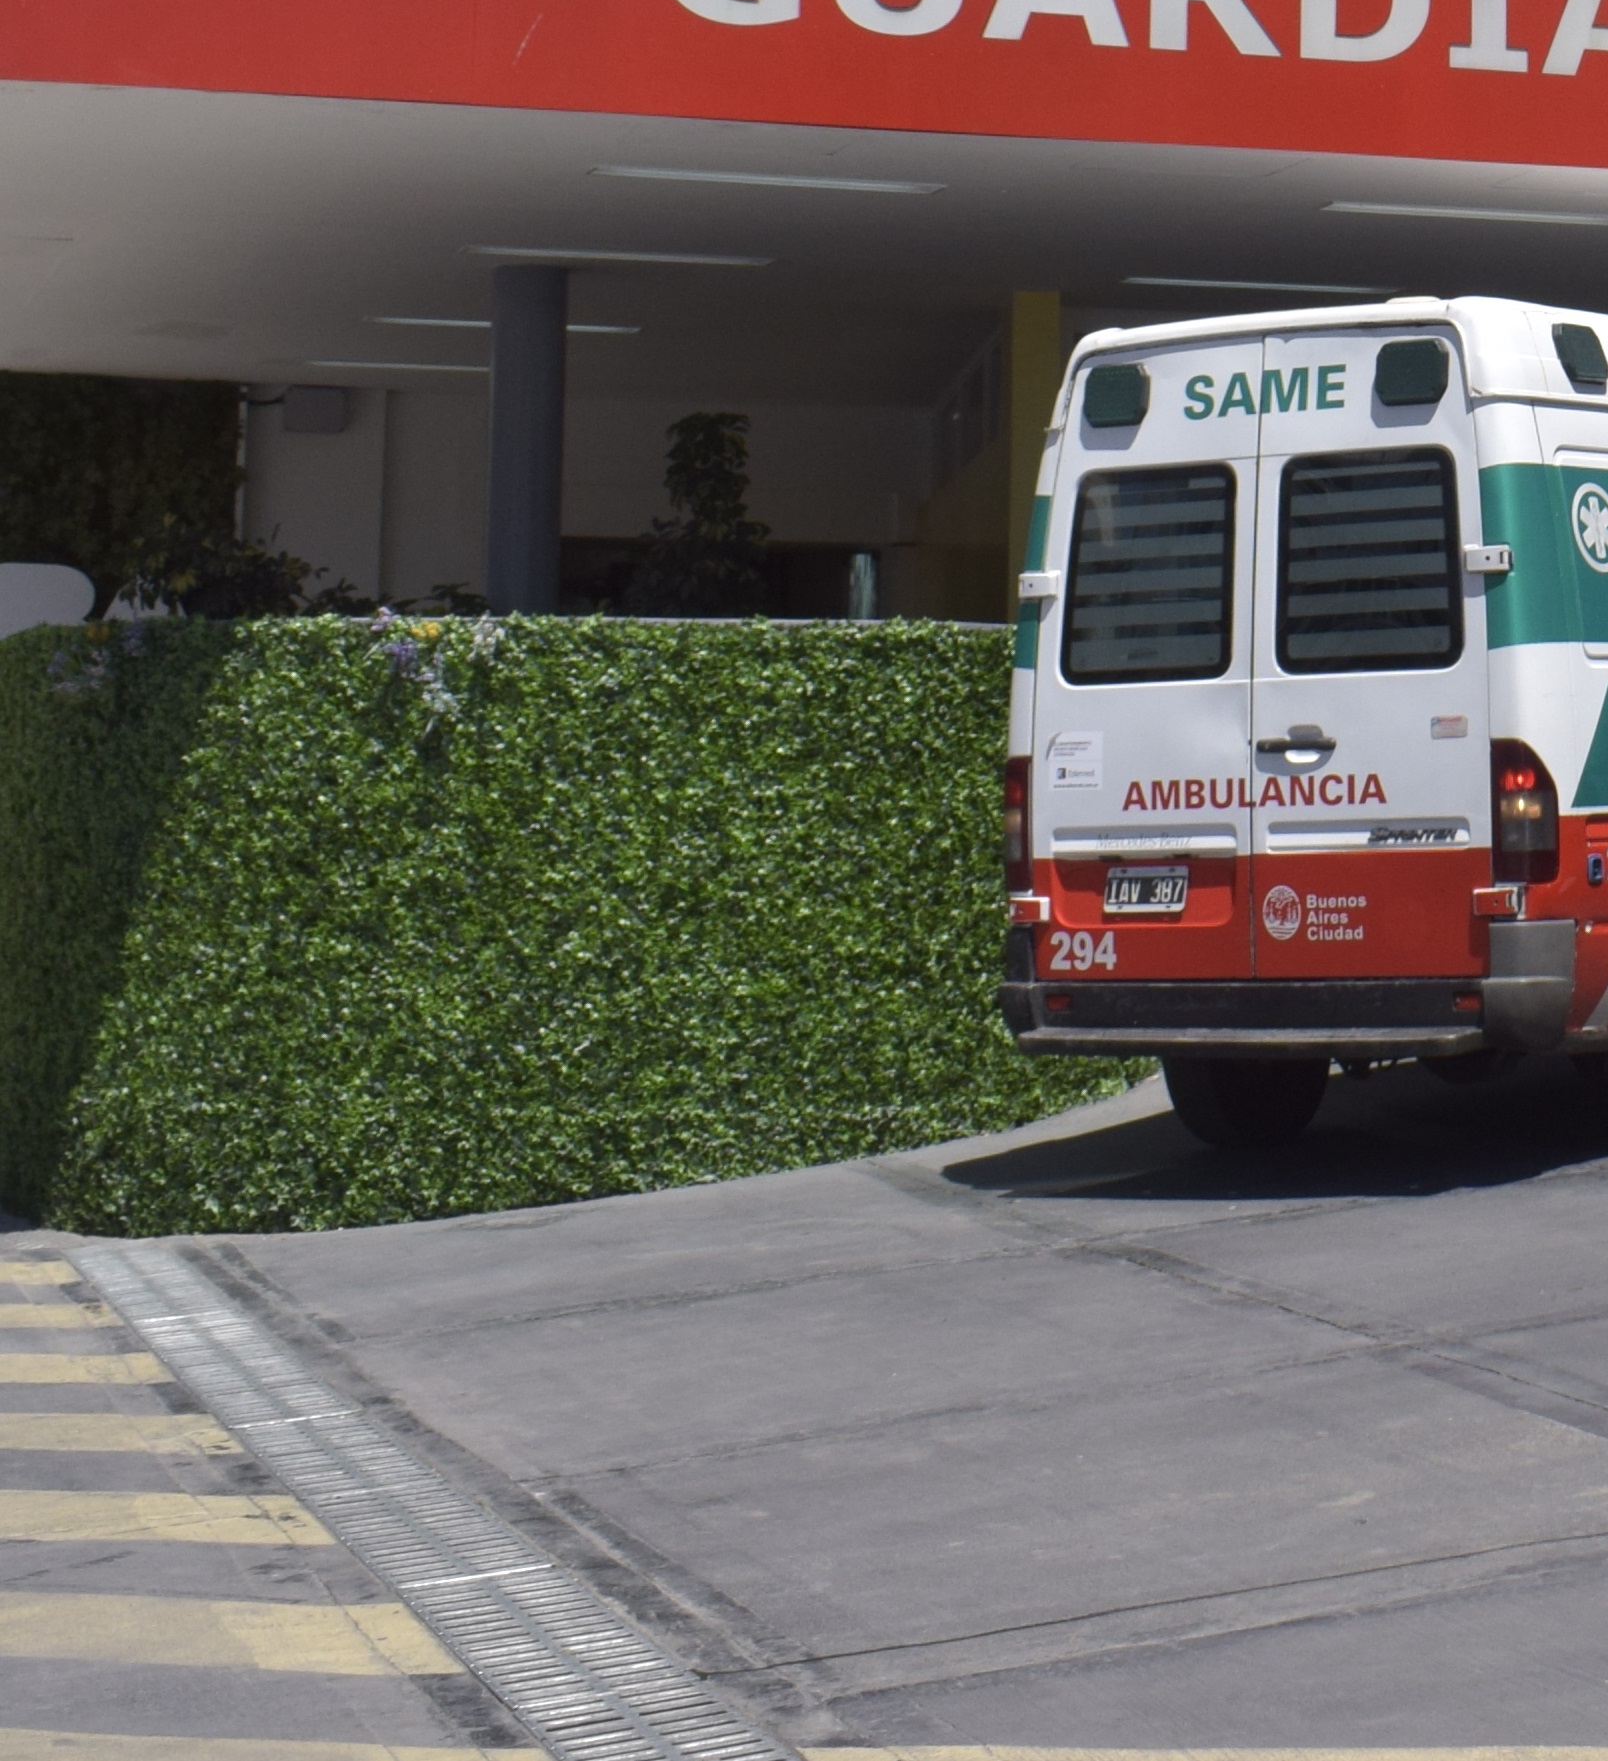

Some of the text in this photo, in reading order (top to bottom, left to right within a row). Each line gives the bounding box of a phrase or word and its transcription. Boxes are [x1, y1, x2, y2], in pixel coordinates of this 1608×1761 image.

[1184, 364, 1347, 421] SAME
[1122, 773, 1387, 811] AMBULANCIA
[1108, 877, 1184, 904] IAV 387
[1306, 894, 1366, 909] Buenos
[1306, 910, 1349, 925] Aires
[1307, 925, 1364, 941] Ciudad
[1050, 931, 1117, 971] 294
